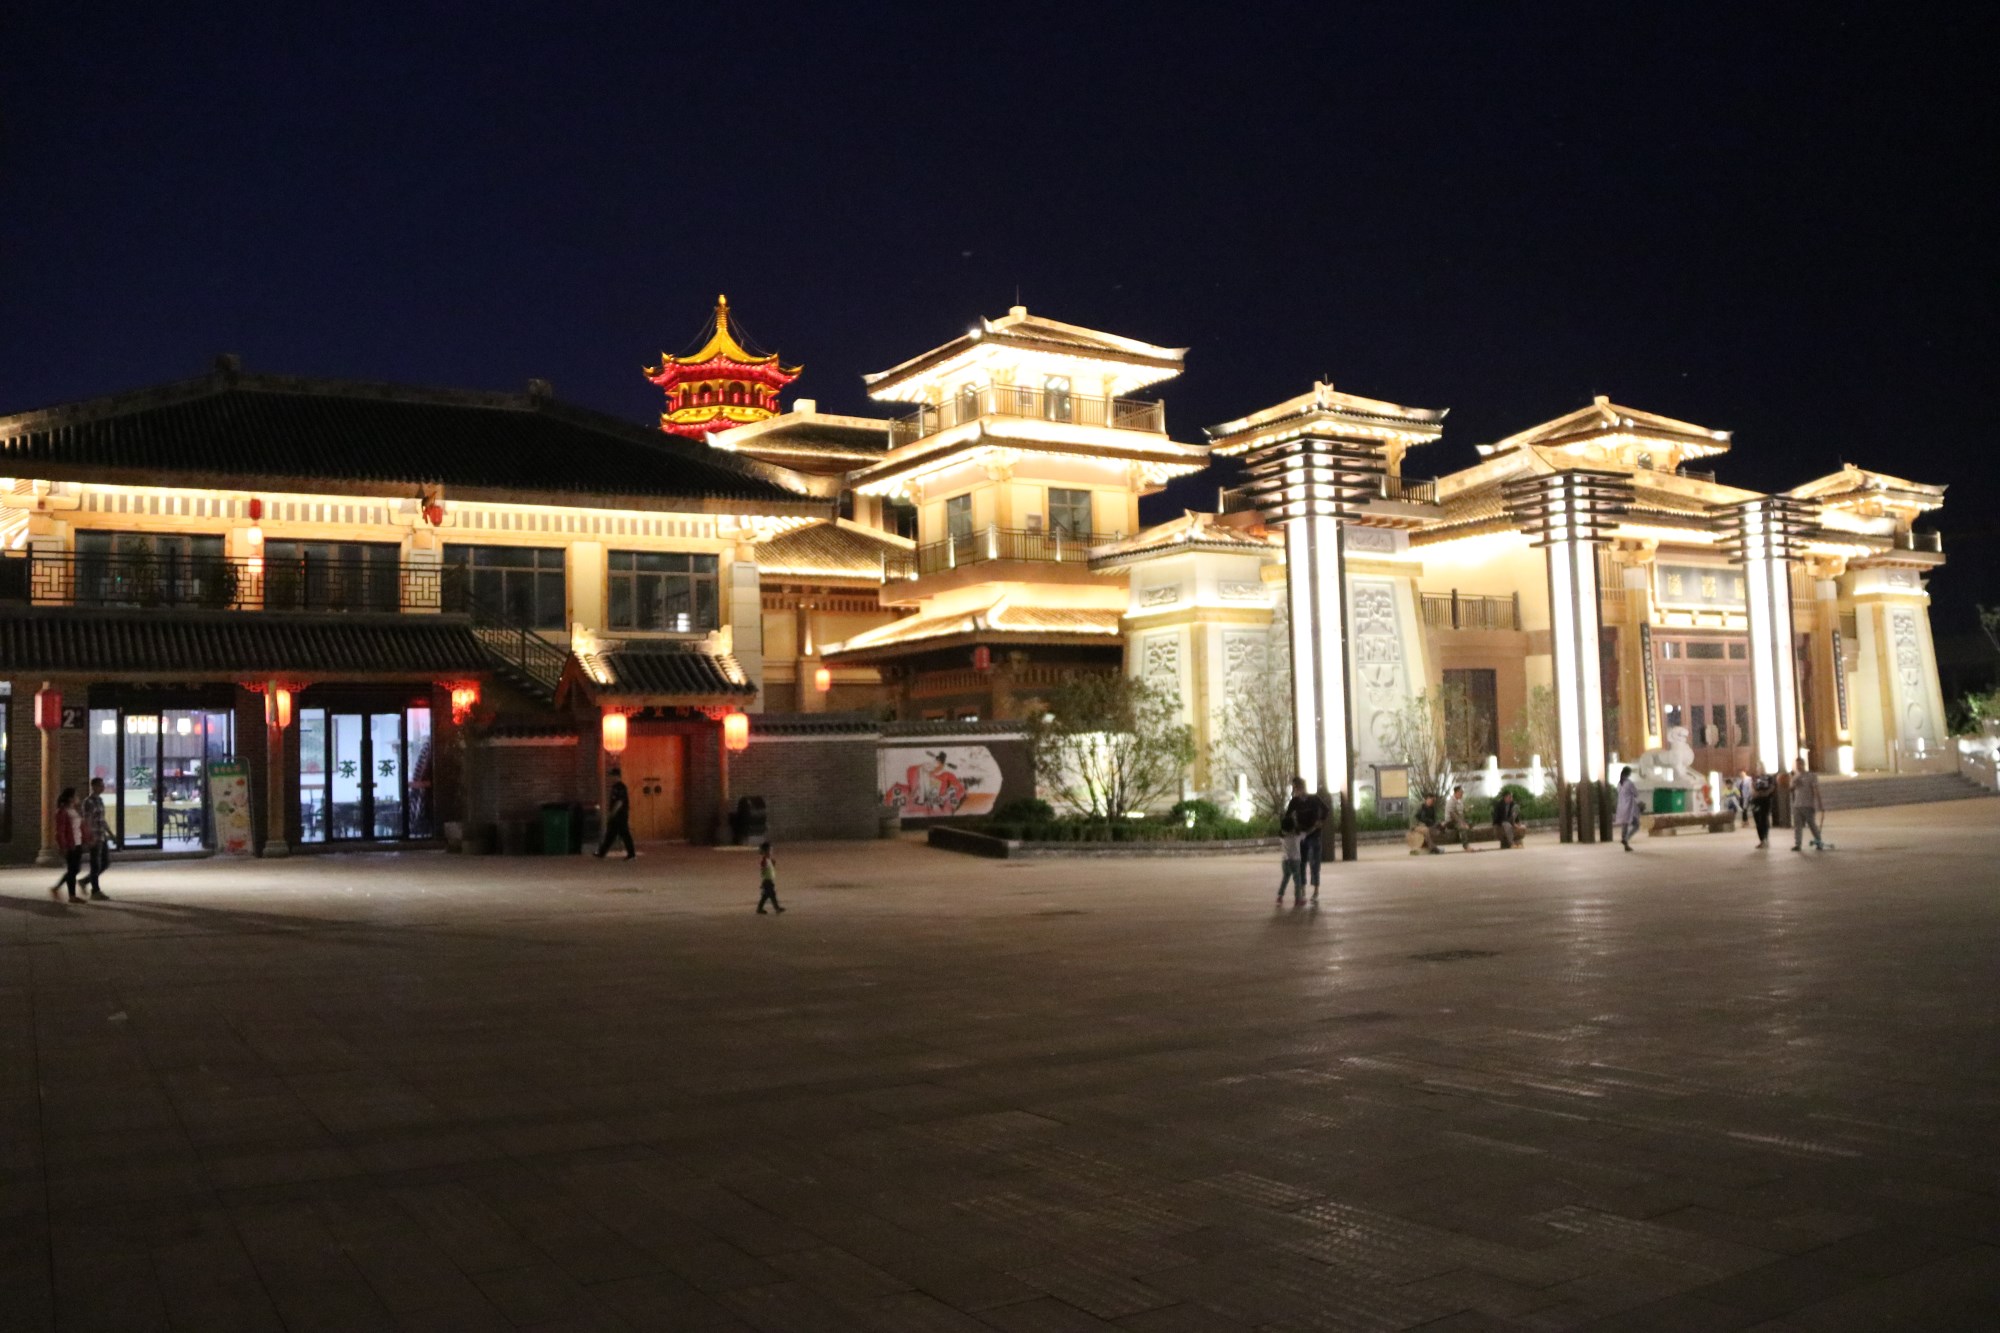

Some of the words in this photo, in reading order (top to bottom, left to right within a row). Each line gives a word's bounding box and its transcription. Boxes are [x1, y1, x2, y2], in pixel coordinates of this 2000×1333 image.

[131, 766, 151, 786] 茶
[338, 760, 357, 778] 茶
[378, 759, 396, 777] 茶
